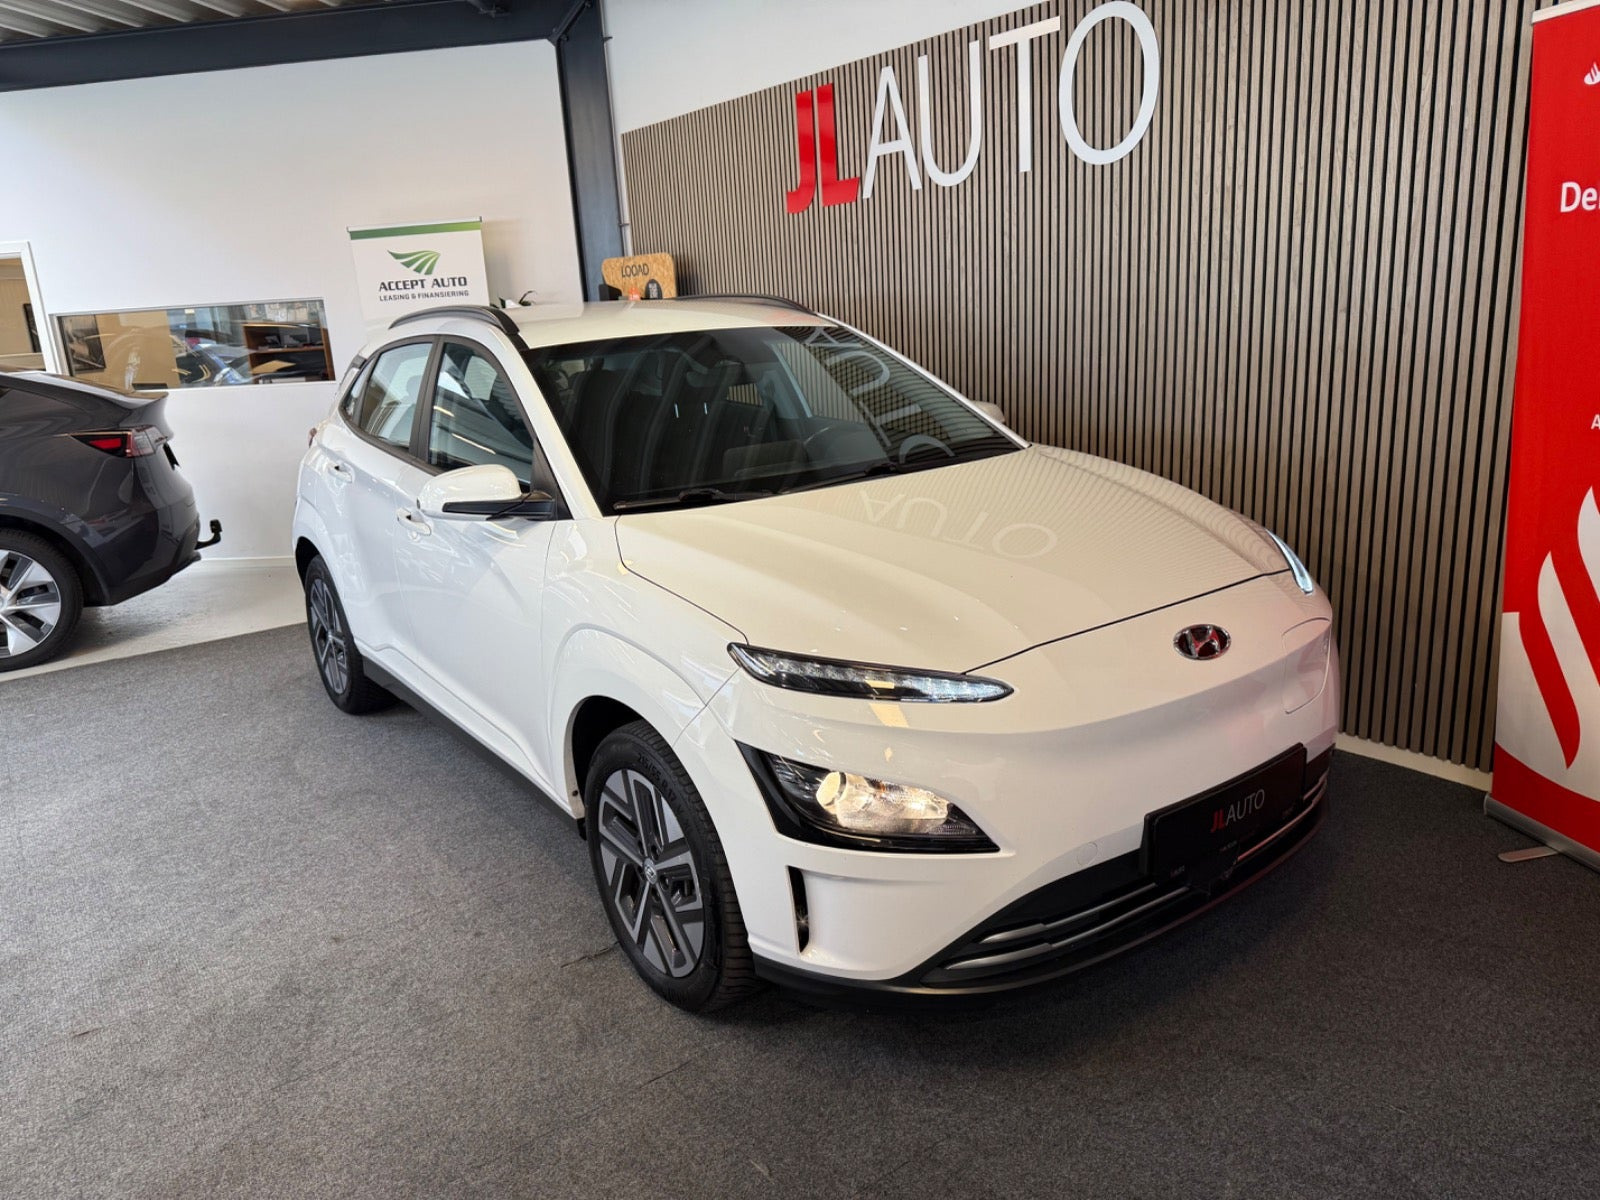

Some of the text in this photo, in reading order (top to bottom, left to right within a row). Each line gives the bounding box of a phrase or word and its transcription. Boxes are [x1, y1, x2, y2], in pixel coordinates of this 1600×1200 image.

[1560, 181, 1600, 213] De
[379, 276, 467, 292] ACCEPT AUTO
[379, 293, 410, 302] LEASING
[418, 289, 469, 299] FINANSIERING
